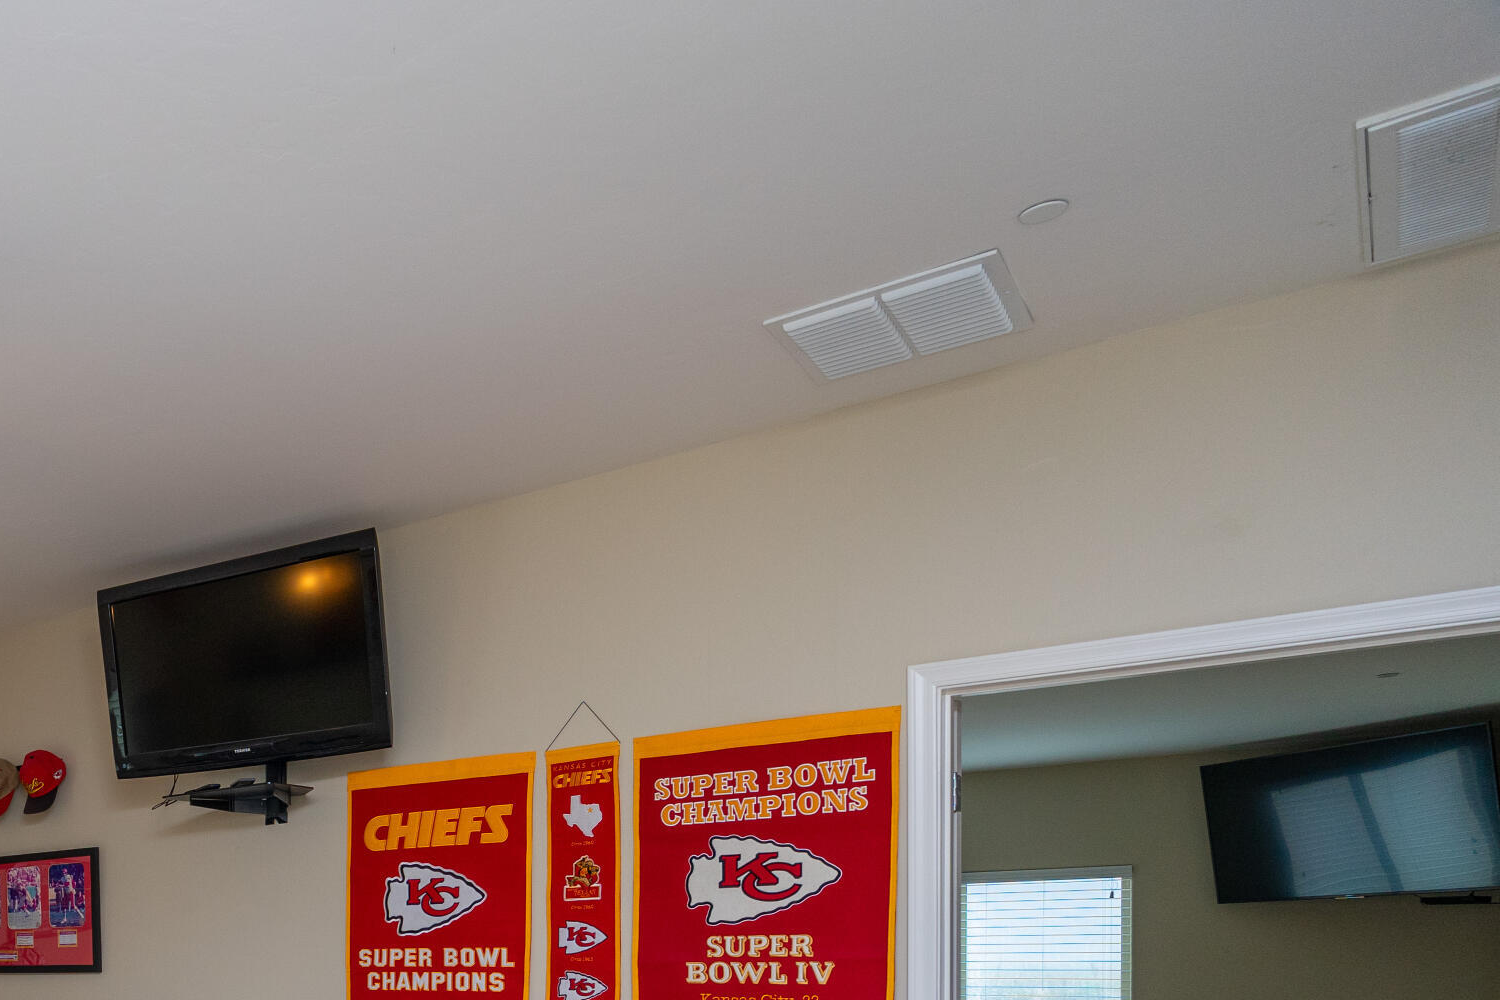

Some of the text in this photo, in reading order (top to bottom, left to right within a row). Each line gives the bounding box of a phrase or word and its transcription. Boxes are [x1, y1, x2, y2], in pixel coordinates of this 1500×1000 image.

[553, 768, 613, 788] CHIEFS
[653, 757, 876, 801] SUPER BOWL
[660, 786, 869, 827] CHAMPIONS
[363, 803, 514, 852] CHIEFS
[719, 852, 803, 901] KC
[406, 878, 460, 917] KC
[358, 947, 515, 968] SUPER BOWL
[706, 934, 815, 958] SUPER
[366, 972, 505, 992] CHAMPIONS
[685, 961, 836, 985] BOWL IV
